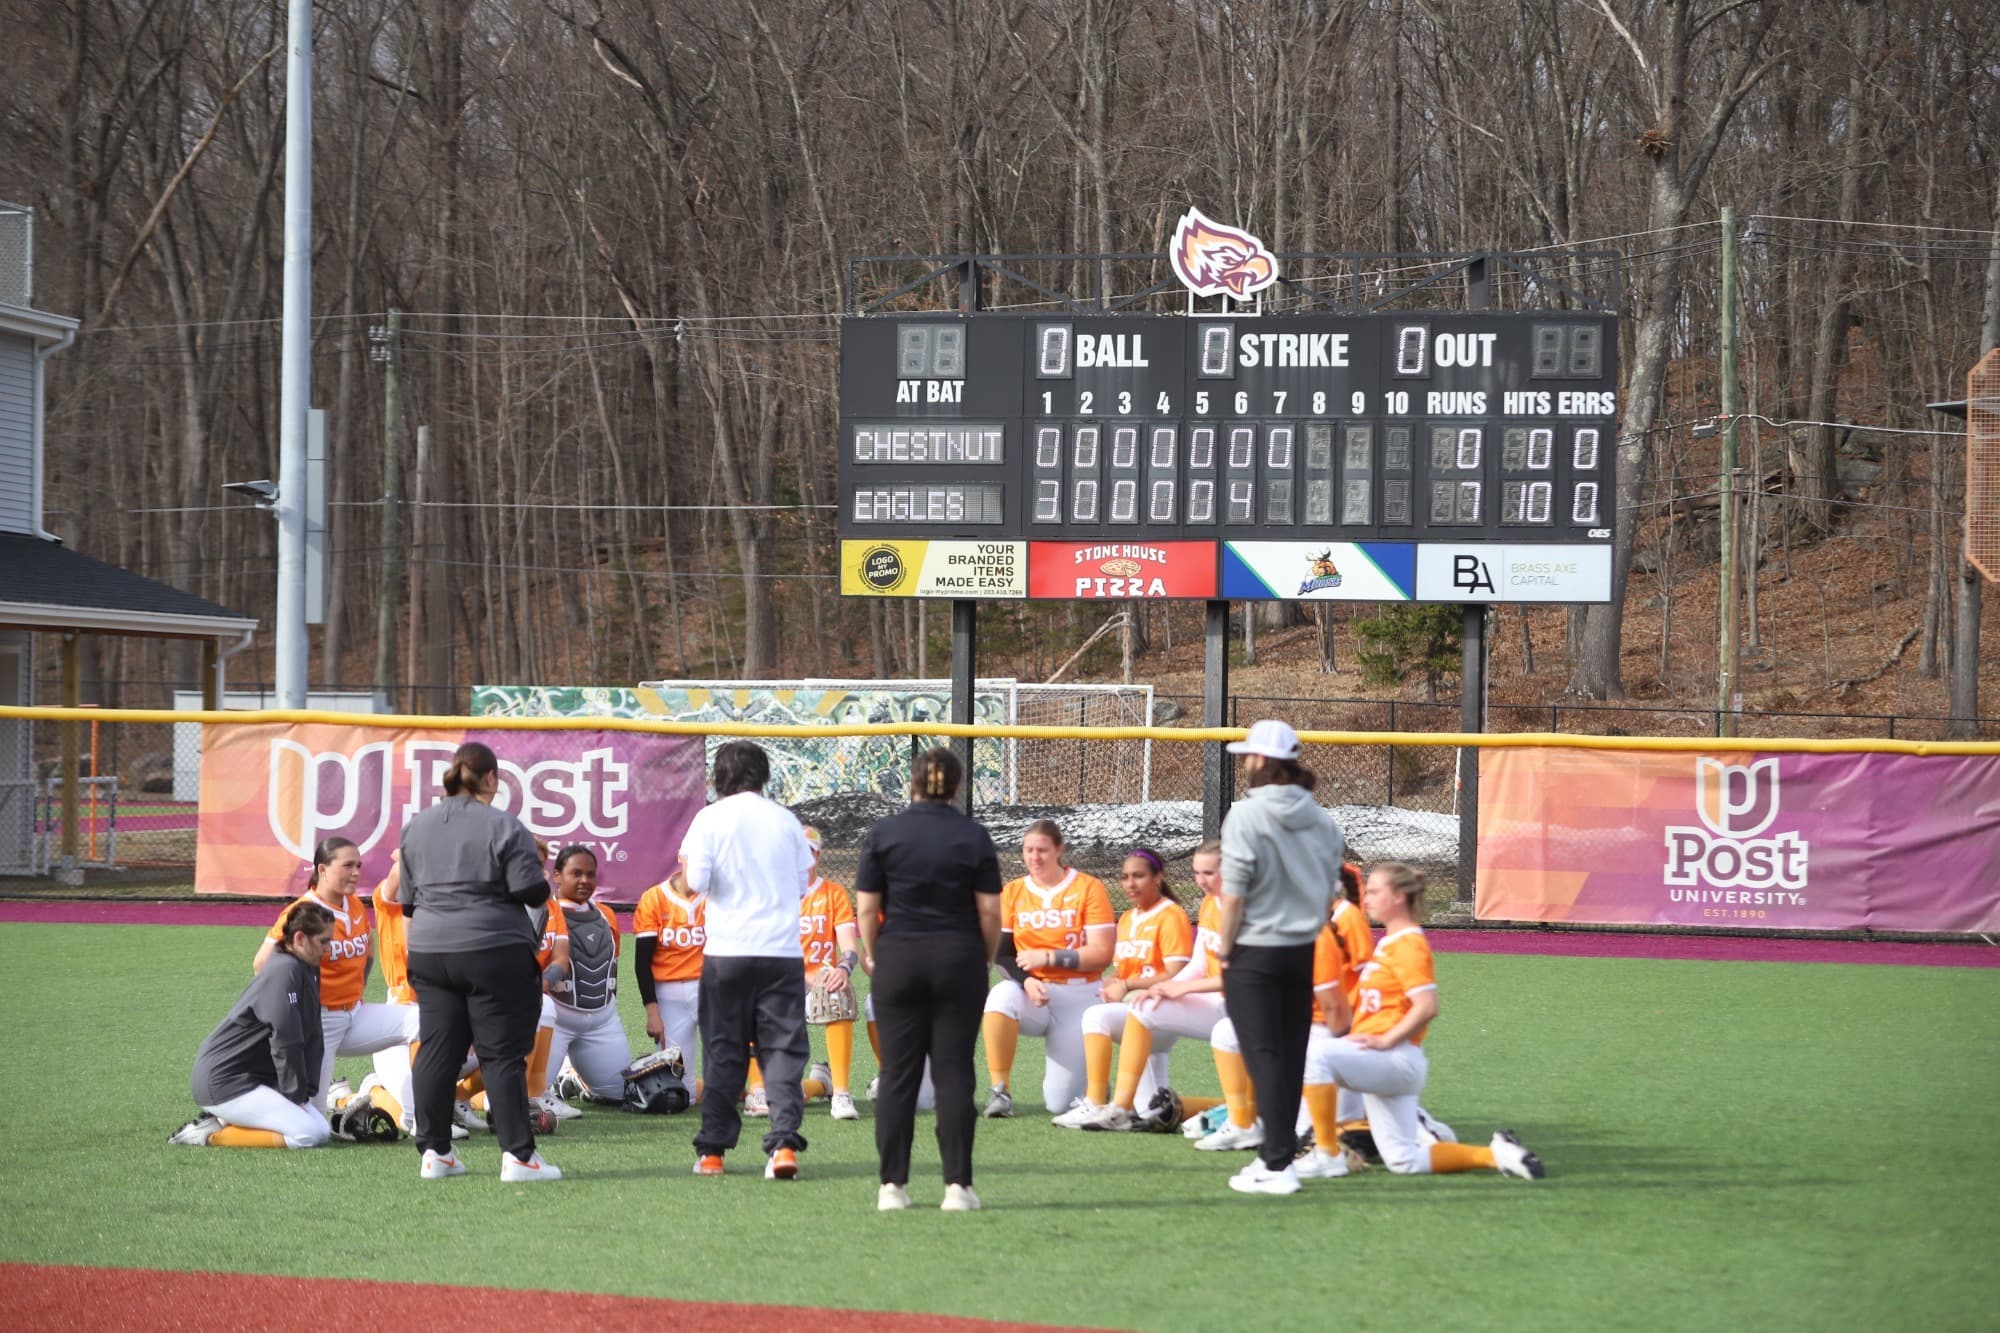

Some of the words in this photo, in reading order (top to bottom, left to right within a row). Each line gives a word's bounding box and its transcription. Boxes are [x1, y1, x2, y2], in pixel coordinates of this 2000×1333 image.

[1040, 327, 1068, 374] 0
[1077, 334, 1149, 367] BALL
[1202, 327, 1229, 374] 0
[1240, 334, 1349, 367] STRIKE
[1397, 327, 1425, 374] 0
[1435, 333, 1497, 367] OUT
[896, 380, 921, 403] AT
[927, 380, 965, 403] BAT
[1042, 391, 1052, 414] 1
[1080, 391, 1093, 414] 2
[1118, 391, 1131, 414] 3
[1156, 391, 1170, 414] 4
[1196, 391, 1209, 414] 5
[1235, 391, 1248, 414] 6
[1273, 391, 1287, 414] 7
[1312, 391, 1326, 414] 8
[1351, 391, 1365, 414] 9
[1385, 391, 1409, 414] 10
[1427, 391, 1487, 414] RUNS
[1503, 391, 1551, 414] HITS
[1558, 391, 1615, 415] ERRS
[855, 432, 1002, 460] CHESTNUT
[1036, 428, 1060, 467] 0
[1074, 428, 1098, 467] 0
[1112, 428, 1137, 467] 0
[1151, 428, 1175, 467] 0
[1190, 428, 1214, 467] 0
[1229, 428, 1253, 468] 0
[1268, 428, 1292, 468] 0
[1456, 428, 1482, 469] 0
[1527, 428, 1553, 469] 0
[1573, 428, 1599, 469] 0
[855, 491, 964, 520] EAGLES
[1036, 480, 1059, 519] 3
[1074, 480, 1098, 519] 0
[1112, 480, 1136, 519] 0
[1150, 480, 1175, 519] 0
[1189, 480, 1214, 520] 0
[1230, 482, 1252, 519] 4
[1460, 482, 1481, 521] 7
[1519, 482, 1552, 522] 10
[1572, 482, 1598, 522] 0
[977, 544, 1014, 554] YOUR
[1075, 545, 1120, 564] STONE
[1122, 545, 1167, 564] HOUSE
[872, 556, 894, 565] LOGO
[949, 555, 1014, 565] BRANDED
[1511, 563, 1551, 574] BRASS
[1554, 563, 1577, 574] AXE
[868, 567, 898, 579] PROMO
[973, 566, 1014, 576] ITEMS
[1511, 575, 1560, 586] CAPITAL
[936, 577, 974, 587] MADE
[979, 577, 1014, 588] EASY
[1076, 577, 1167, 597] PIZZA
[1664, 825, 1809, 888] Post
[800, 915, 827, 935] ST
[1017, 909, 1077, 929] POST
[662, 926, 705, 947] POS
